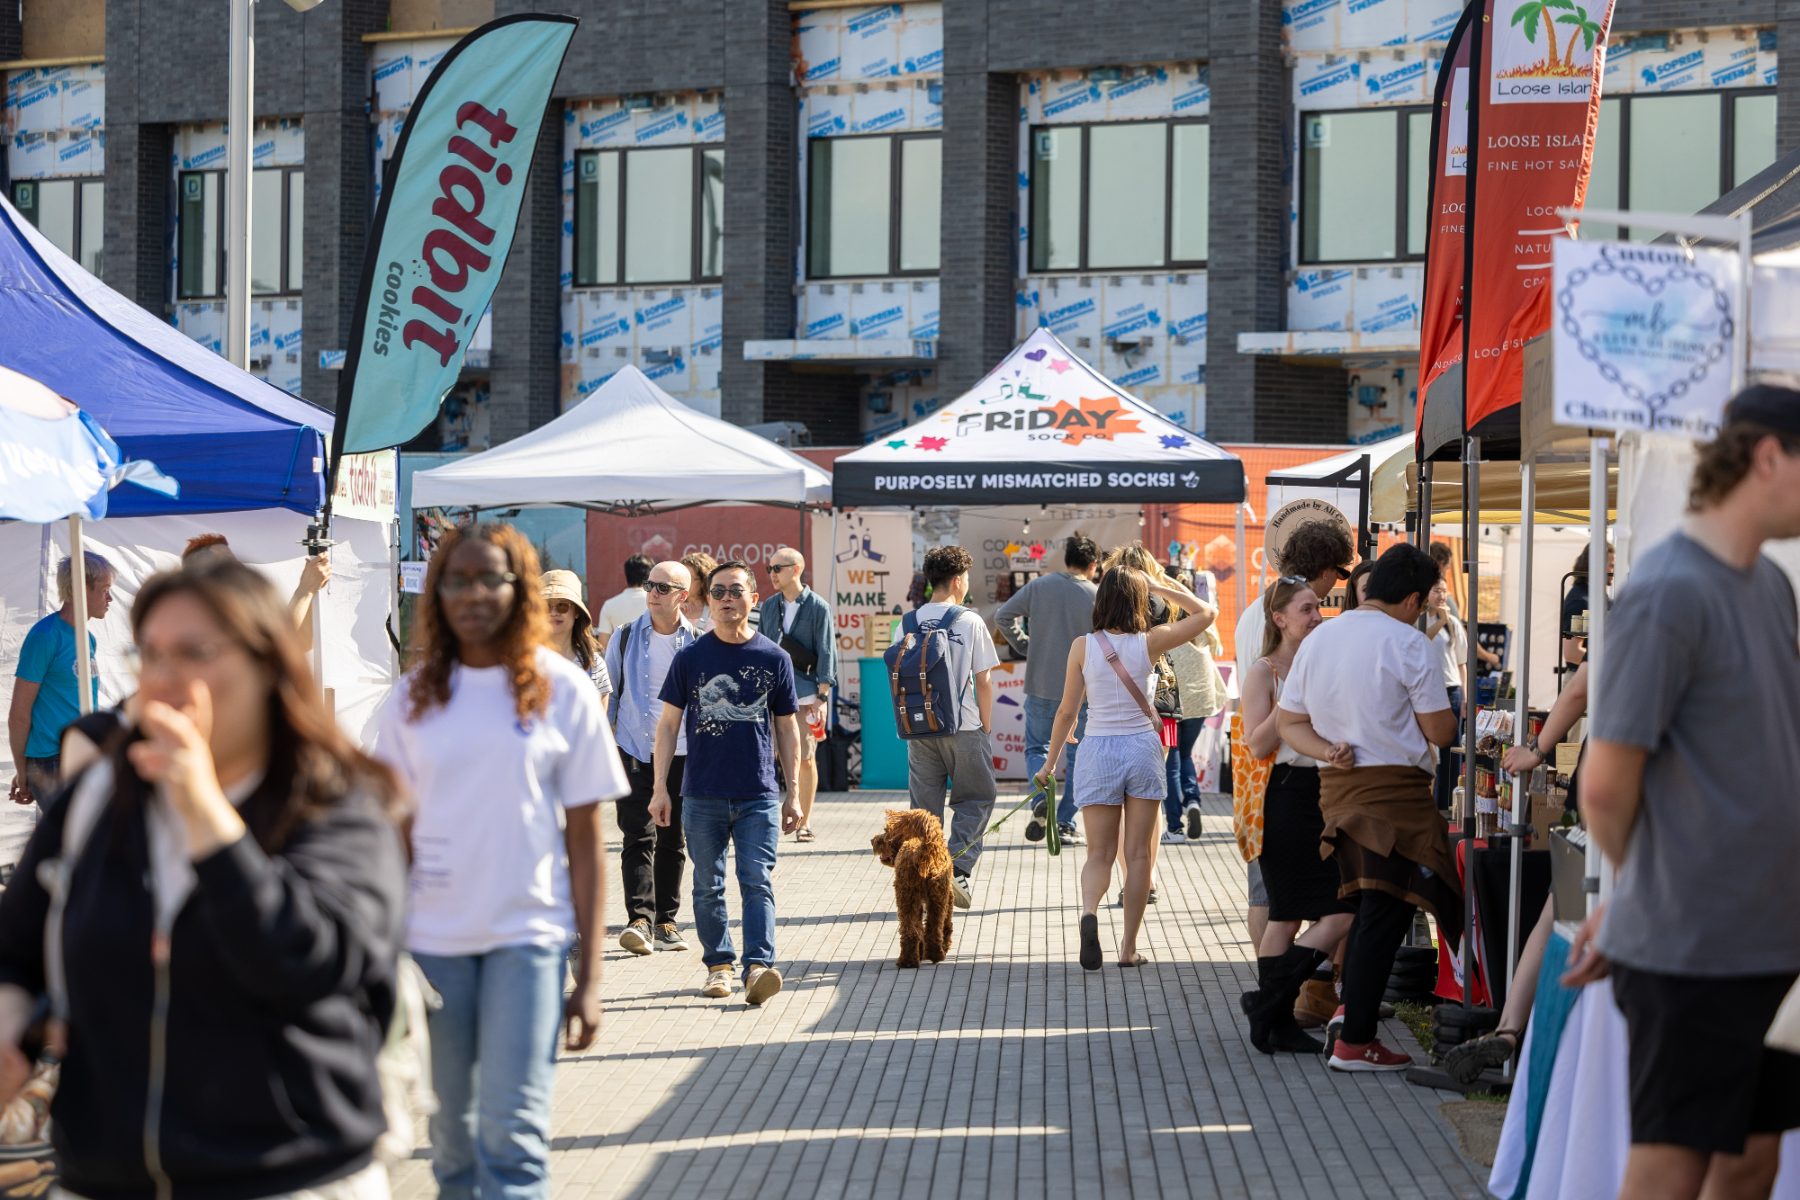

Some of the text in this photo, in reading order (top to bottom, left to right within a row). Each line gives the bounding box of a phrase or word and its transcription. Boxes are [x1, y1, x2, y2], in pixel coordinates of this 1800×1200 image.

[1498, 82, 1550, 96] Loose
[1488, 135, 1540, 148] LOOSE
[1488, 161, 1518, 171] FINE
[1525, 160, 1554, 171] HOT
[403, 101, 518, 367] tidbit
[373, 261, 404, 357] cookies
[1565, 400, 1645, 423] Charm
[1028, 433, 1075, 441] SOCK
[875, 472, 1175, 491] PURPOSELY MISMATCHED SOCKS!
[1051, 509, 1117, 519] THESIS
[1272, 501, 1311, 528] Handmade
[1313, 501, 1323, 511] by
[848, 570, 875, 584] WE
[837, 592, 887, 606] MAKE
